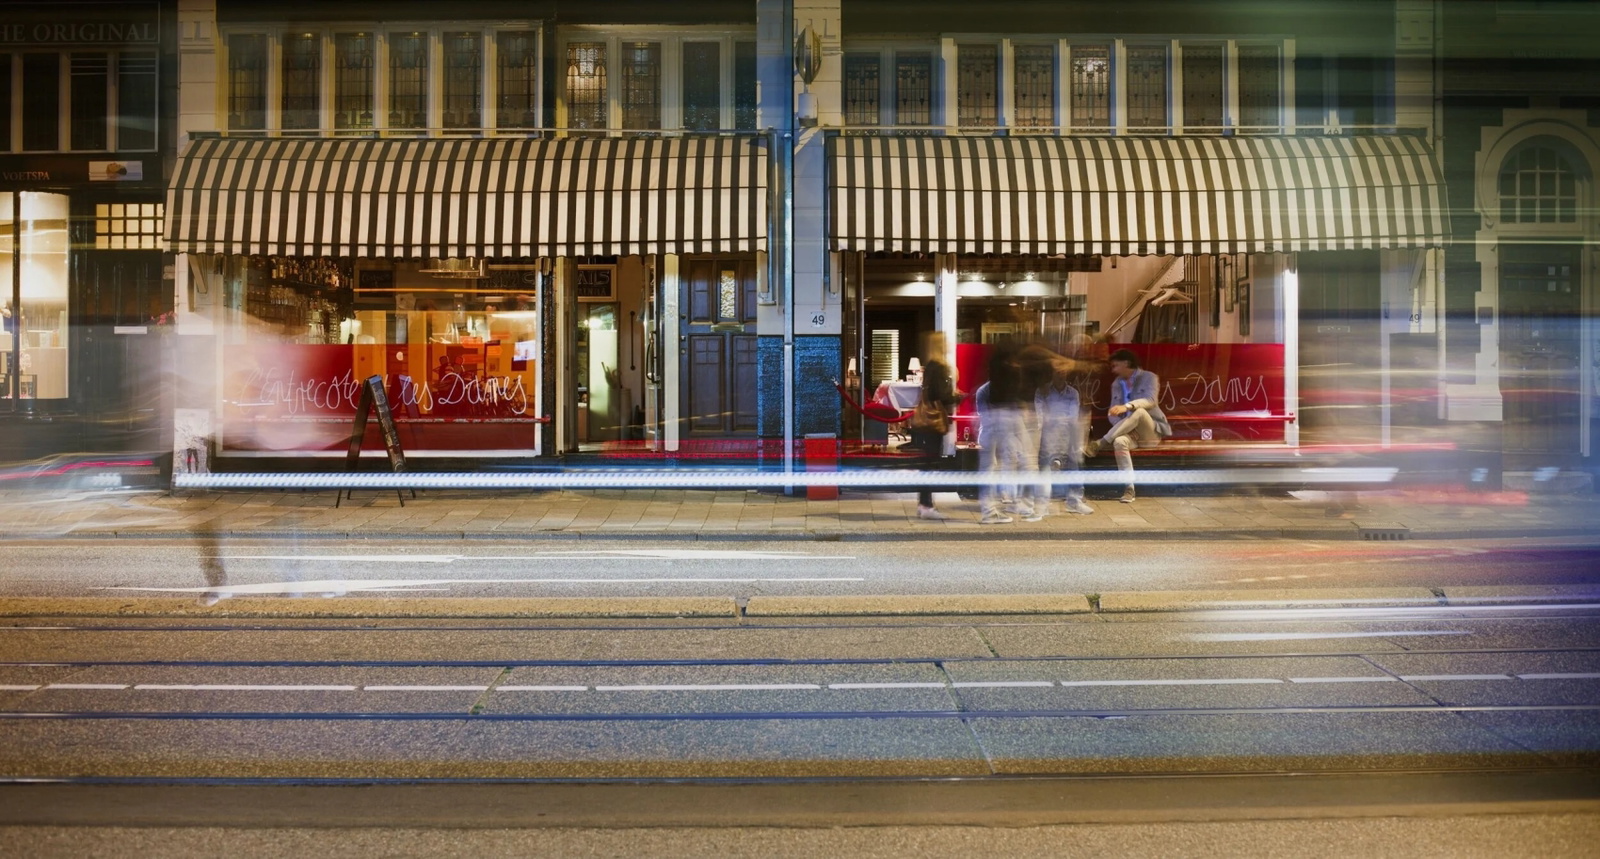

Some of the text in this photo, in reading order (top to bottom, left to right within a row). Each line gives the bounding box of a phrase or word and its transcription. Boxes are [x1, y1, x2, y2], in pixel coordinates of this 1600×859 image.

[0, 23, 157, 42] HE ORIGINAL
[2, 171, 51, 182] VOETSPA
[577, 271, 610, 286] AILS
[811, 314, 825, 326] 49
[1408, 313, 1421, 324] 49
[396, 376, 433, 411] les
[437, 373, 526, 415] Dames
[1180, 372, 1269, 415] Dames
